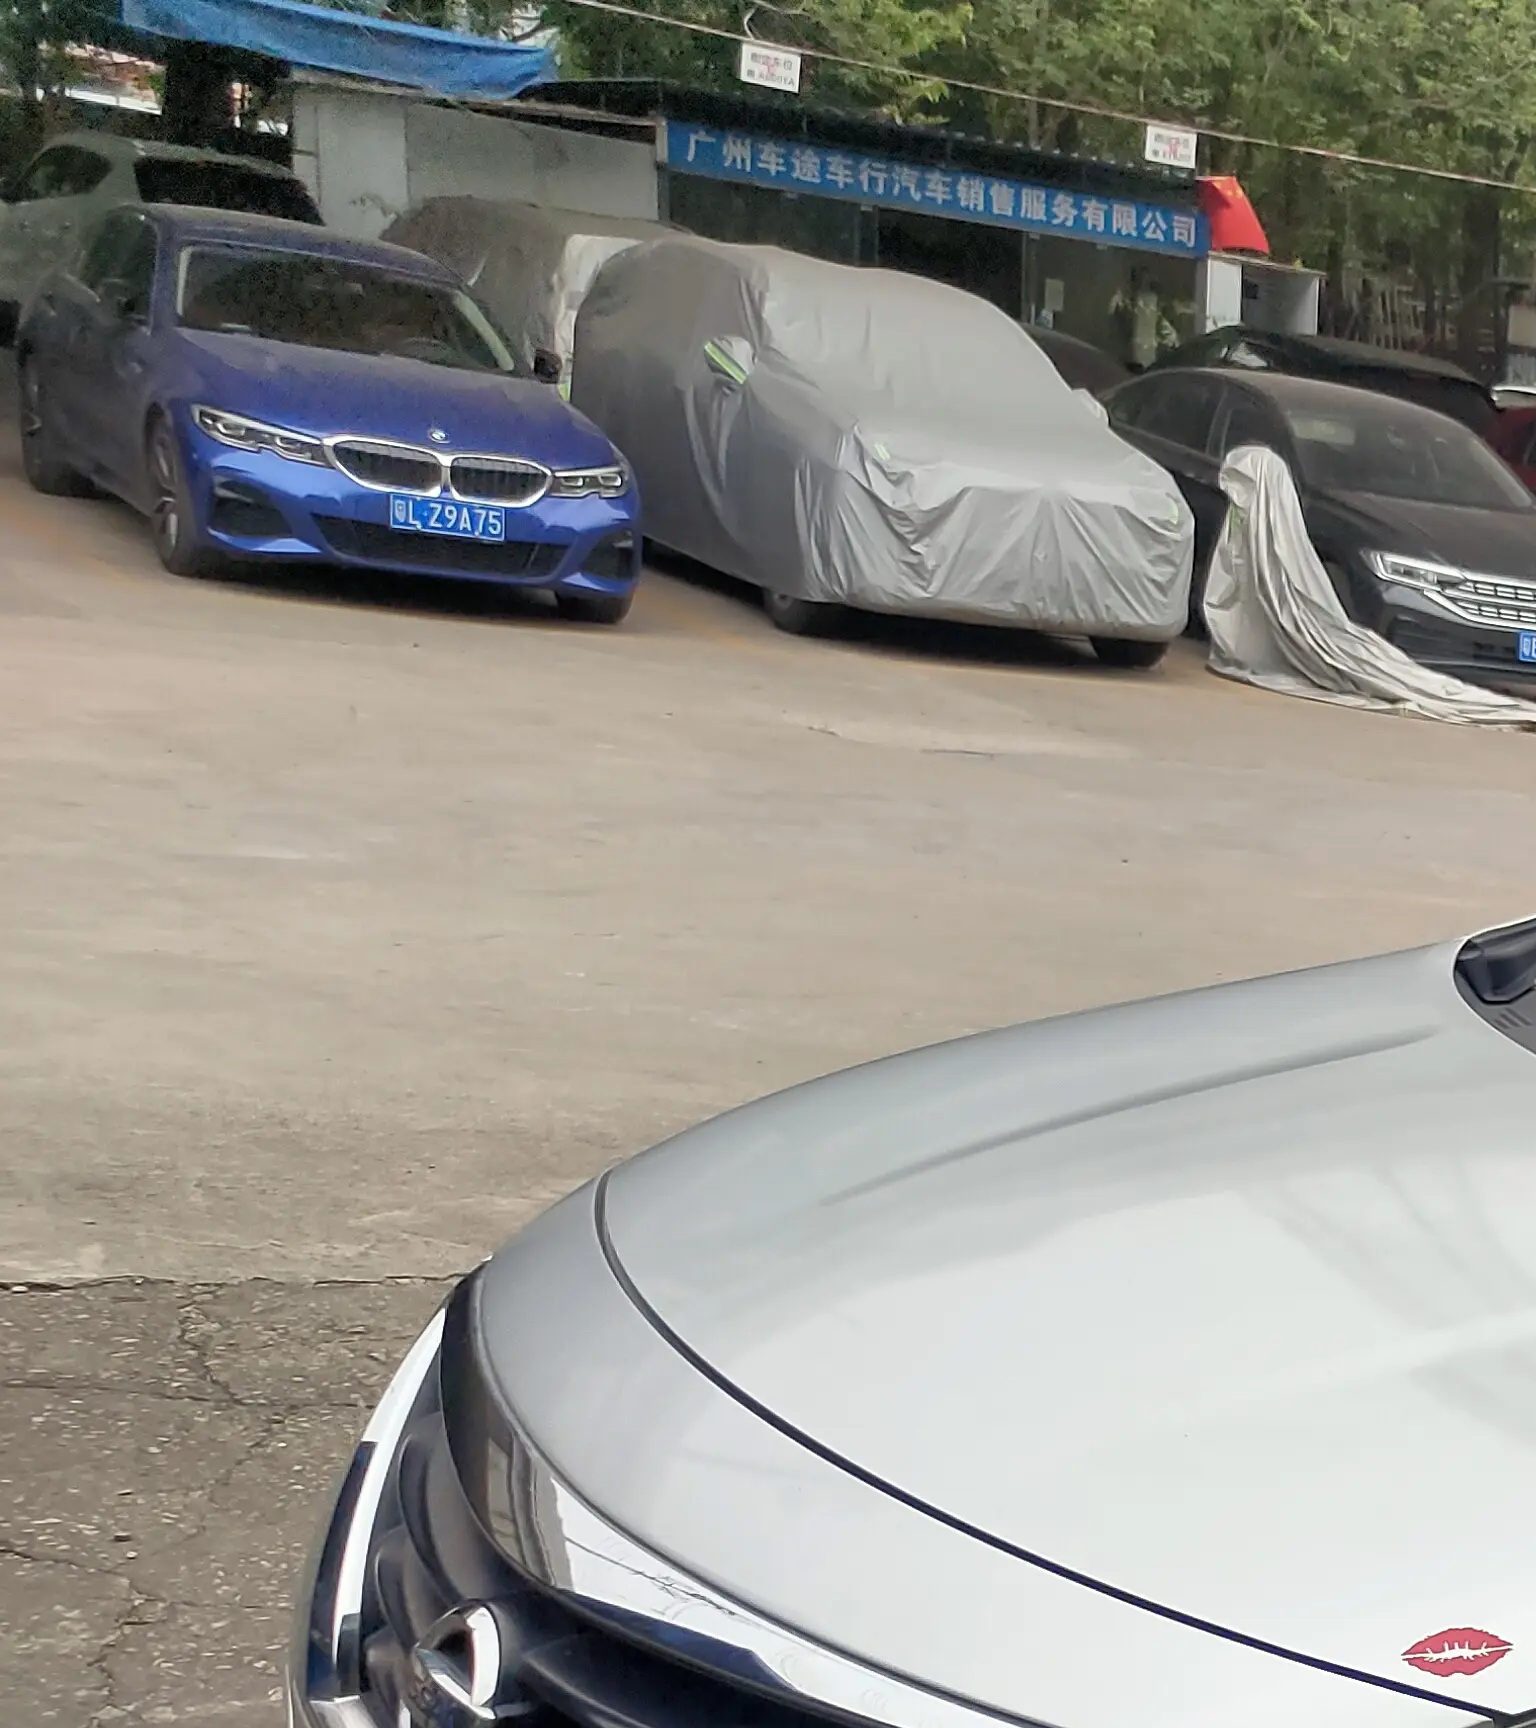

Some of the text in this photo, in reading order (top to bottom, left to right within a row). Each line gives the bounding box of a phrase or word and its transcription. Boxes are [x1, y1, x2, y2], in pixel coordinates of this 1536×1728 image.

[686, 130, 1196, 248] 广州车途车行汽车销售服务有限公司
